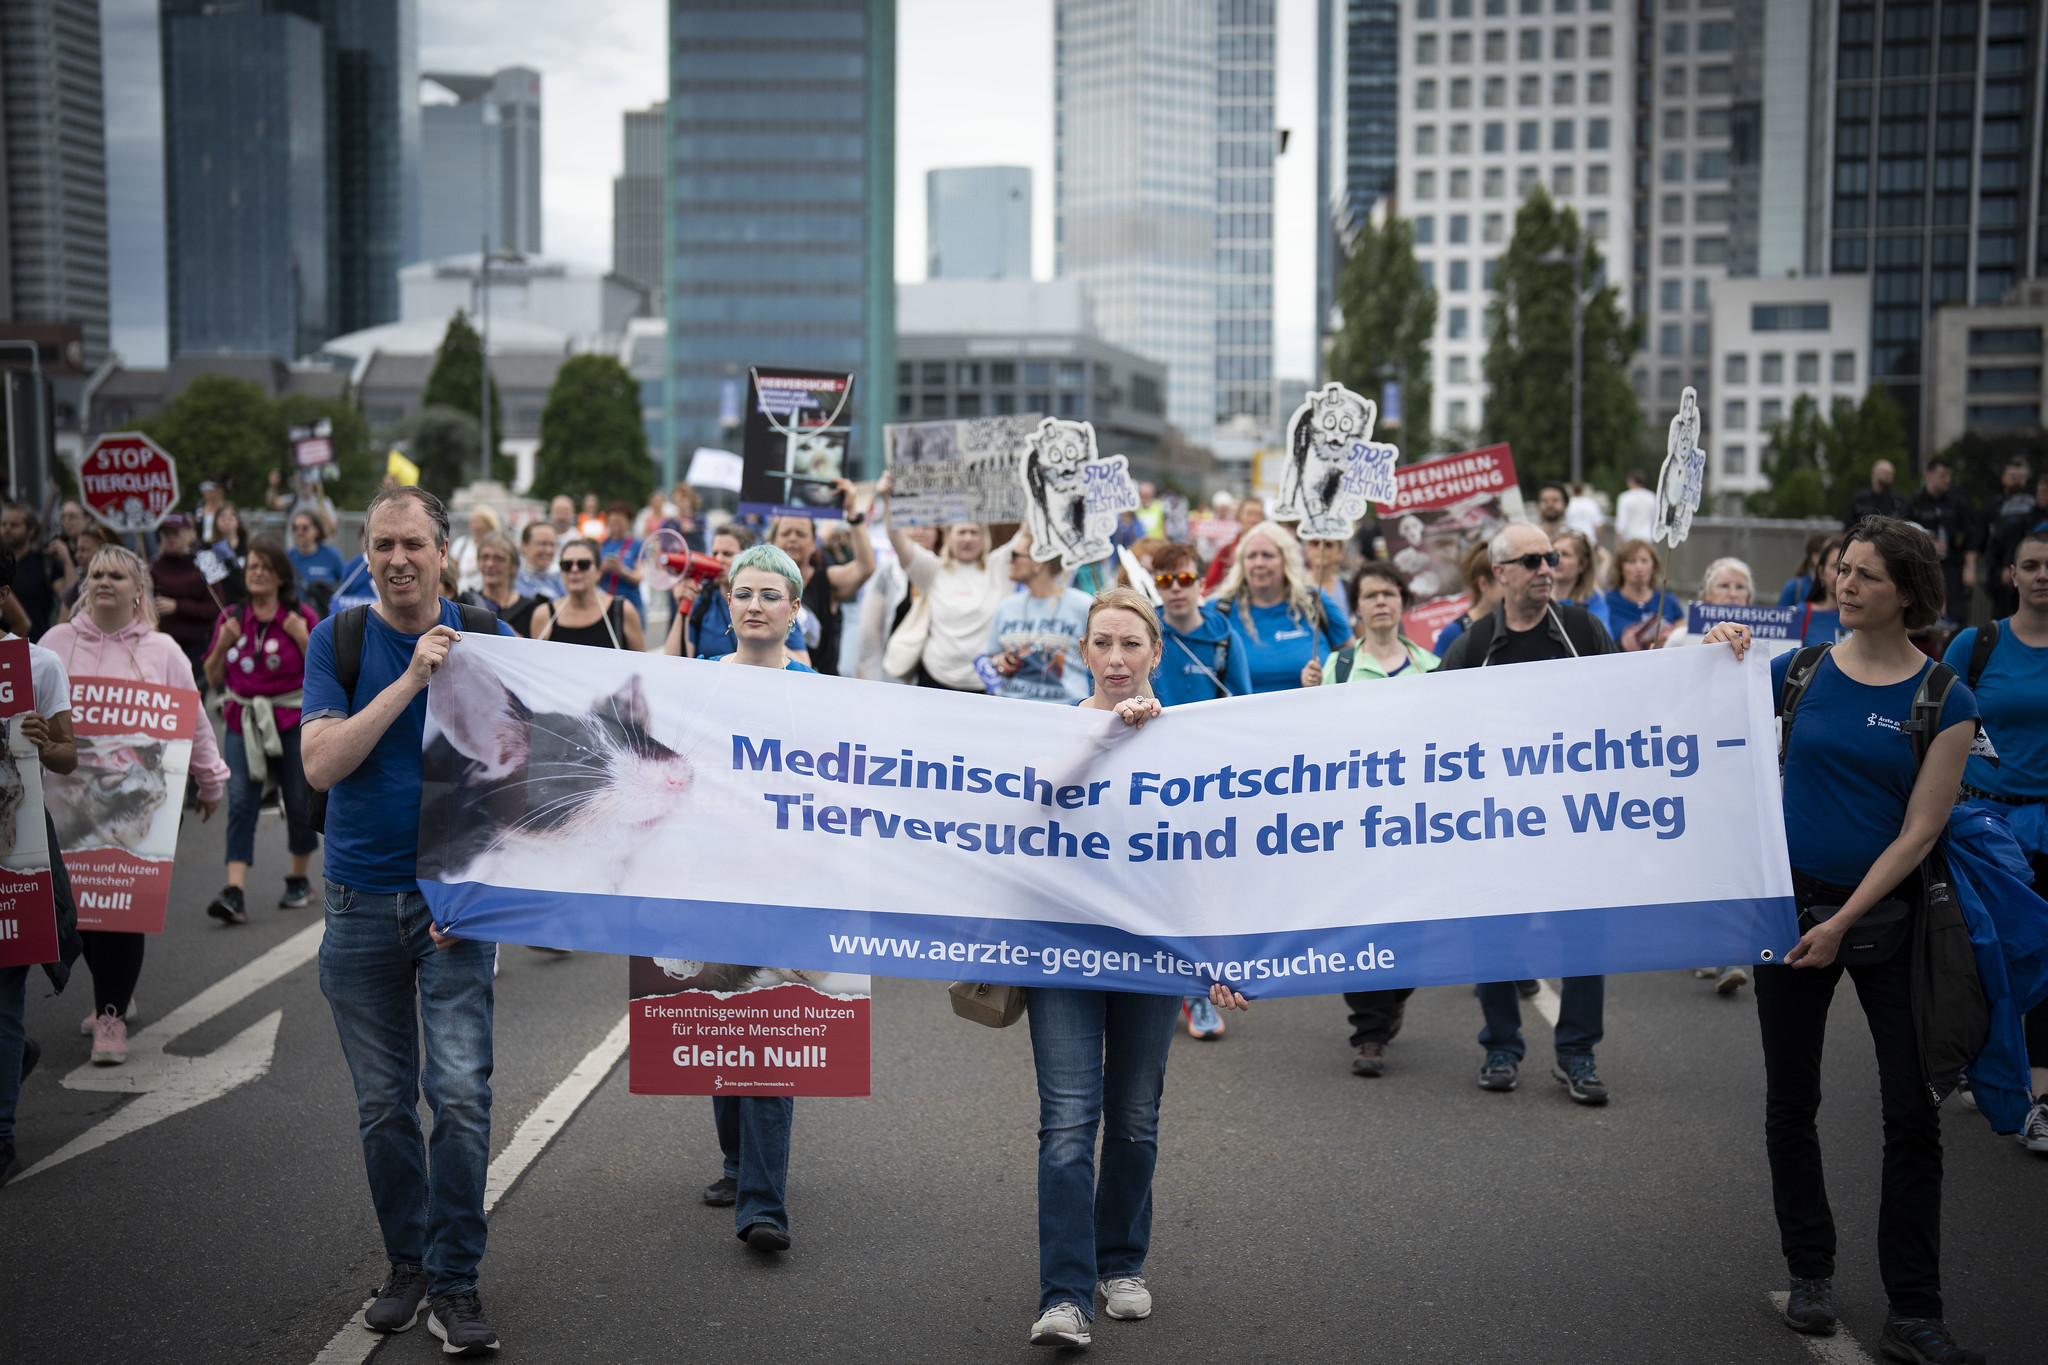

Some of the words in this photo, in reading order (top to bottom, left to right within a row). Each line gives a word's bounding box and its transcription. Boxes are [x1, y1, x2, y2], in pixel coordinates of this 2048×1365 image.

[96, 446, 153, 470] STOP
[1347, 443, 1393, 465] STOP
[83, 471, 171, 494] TIERQUAL
[1083, 461, 1122, 484] STOP
[1347, 461, 1392, 483] ANIMAL
[1397, 454, 1499, 491] FFENHIRN-
[1343, 476, 1392, 500] TESTING
[1396, 469, 1504, 508] ORSCHUNG
[1085, 491, 1136, 514] TESTING
[1700, 605, 1793, 624] TIERVERSUCHE
[1702, 621, 1787, 639] AAFFEN
[71, 684, 180, 711] ENHIRN-
[71, 705, 178, 732] SCHUNG
[731, 734, 1110, 809] Medizinischer
[1129, 750, 1406, 807] Fortschritt
[1423, 742, 1486, 784] ist
[1503, 725, 1701, 777] wichtig
[764, 793, 1109, 860] Tierversuche
[1128, 816, 1237, 863] sind
[1256, 812, 1344, 856] der
[1361, 797, 1547, 848] falsche
[1562, 790, 1686, 840] Weg
[70, 873, 136, 887] Menschen?
[93, 862, 115, 873] und
[118, 863, 160, 876] Nutzen
[79, 890, 132, 910] Null!
[829, 933, 1396, 983] www.aerzte-gegen-tierversuche.de
[644, 1005, 769, 1021] Erkenntnisgewinn
[773, 1006, 800, 1019] und
[804, 1007, 855, 1019] Nutzen
[672, 1023, 692, 1036] für
[697, 1023, 745, 1036] kranke
[749, 1024, 827, 1037] Menschen?
[672, 1044, 755, 1068] Gleich
[764, 1046, 827, 1068] Null!
